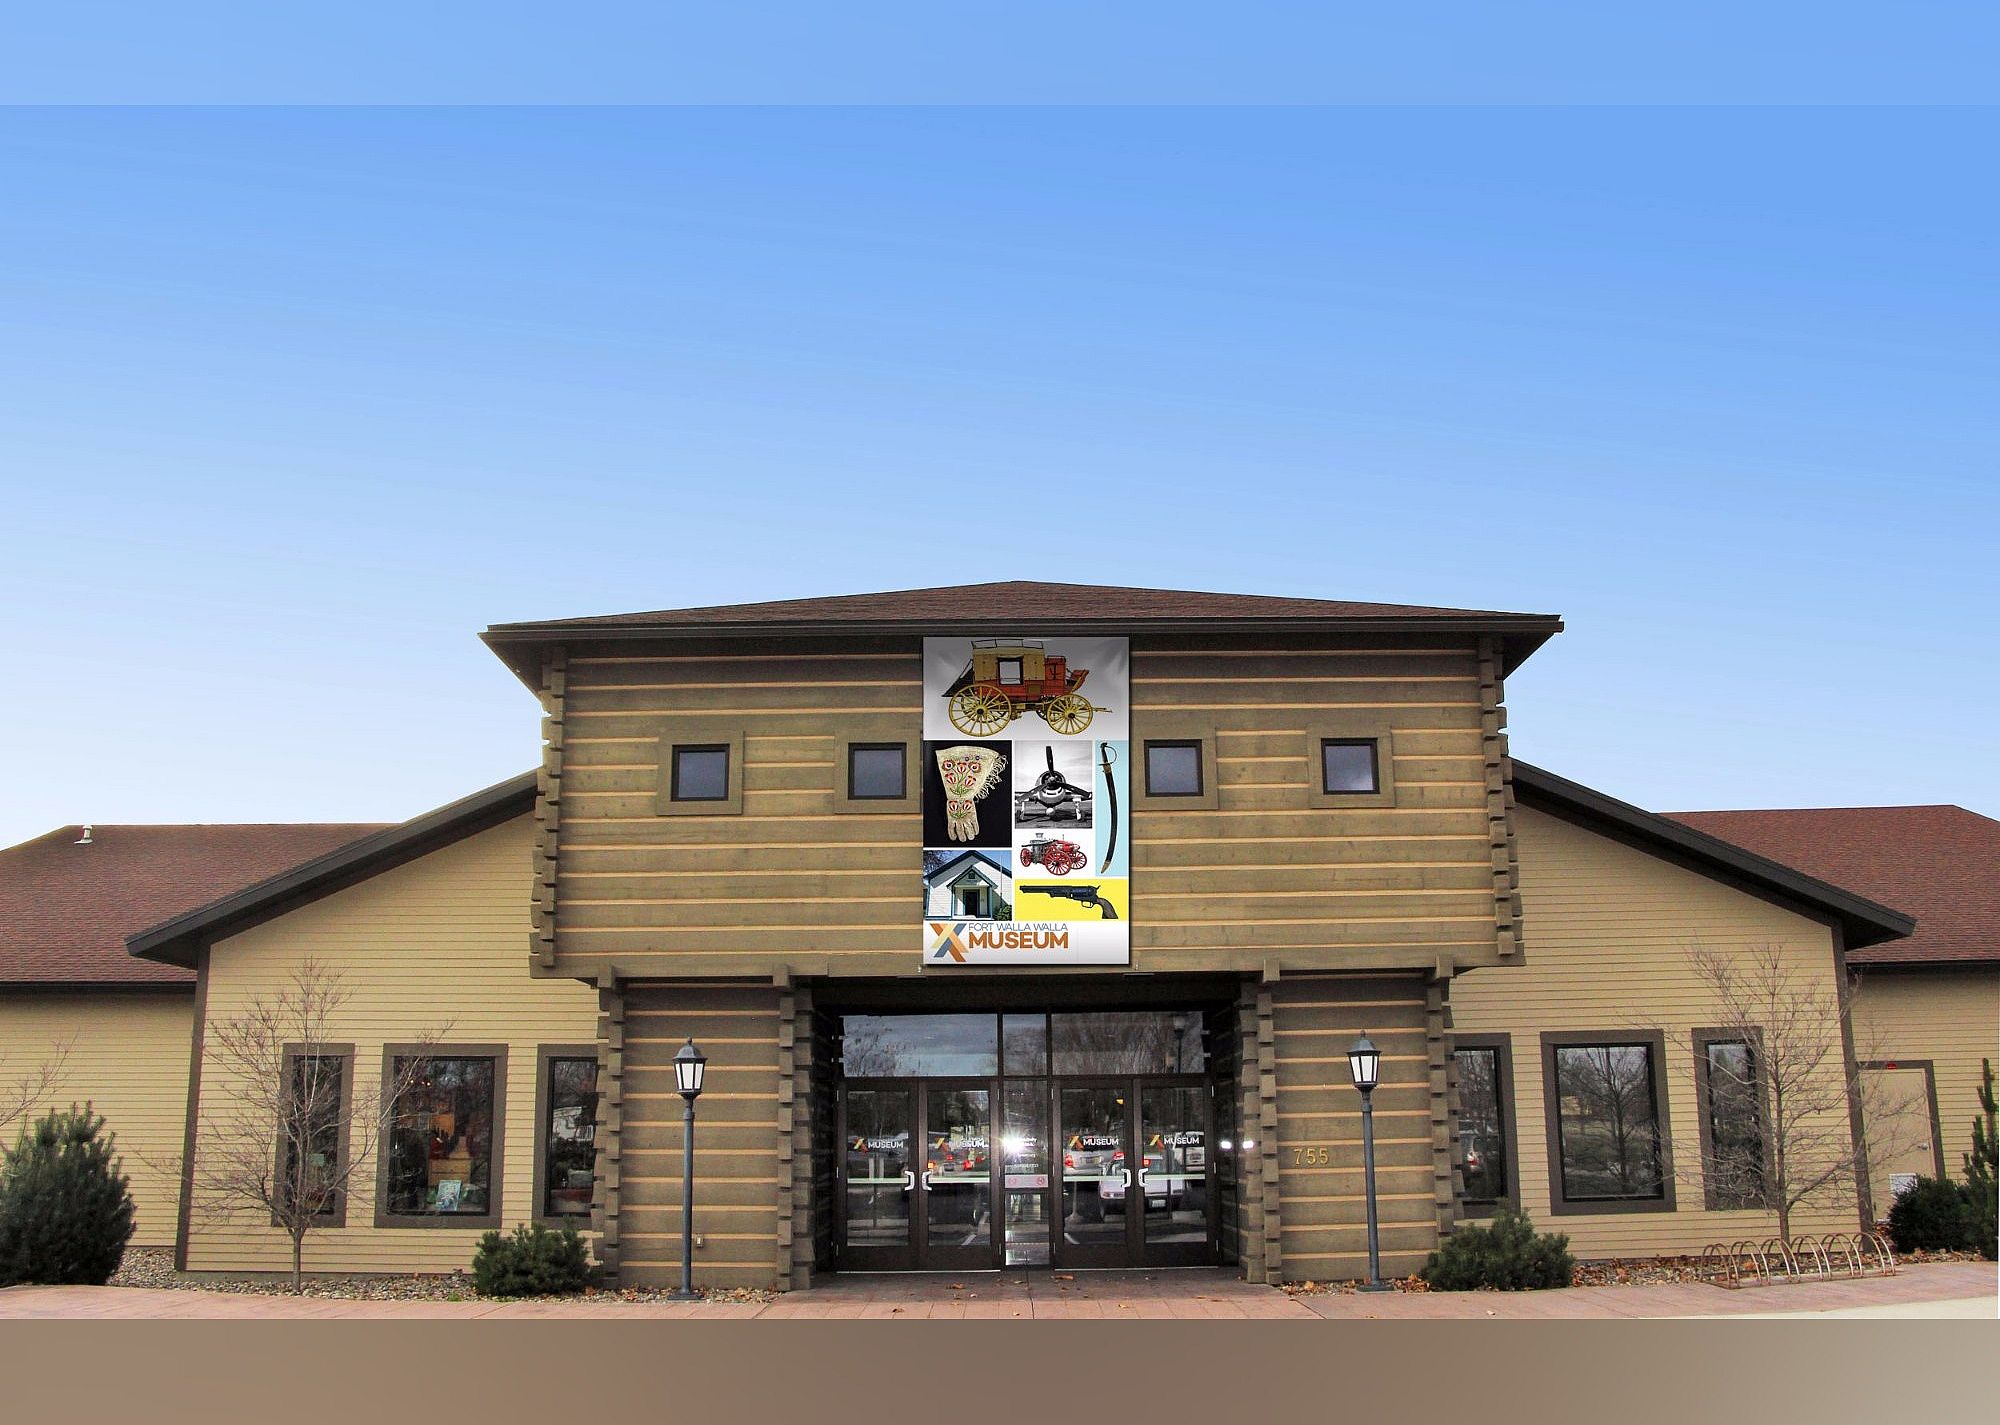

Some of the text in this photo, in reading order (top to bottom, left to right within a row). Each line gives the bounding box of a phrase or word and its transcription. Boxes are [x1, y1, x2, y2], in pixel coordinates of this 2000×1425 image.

[968, 923, 1068, 931] FORT WALLA WALLA
[968, 931, 1069, 949] MUSEUM
[1083, 1138, 1119, 1146] MUSEUM
[1163, 1136, 1200, 1145] MUSEUM
[867, 1141, 904, 1149] MUSEUM
[1293, 1148, 1329, 1165] 755
